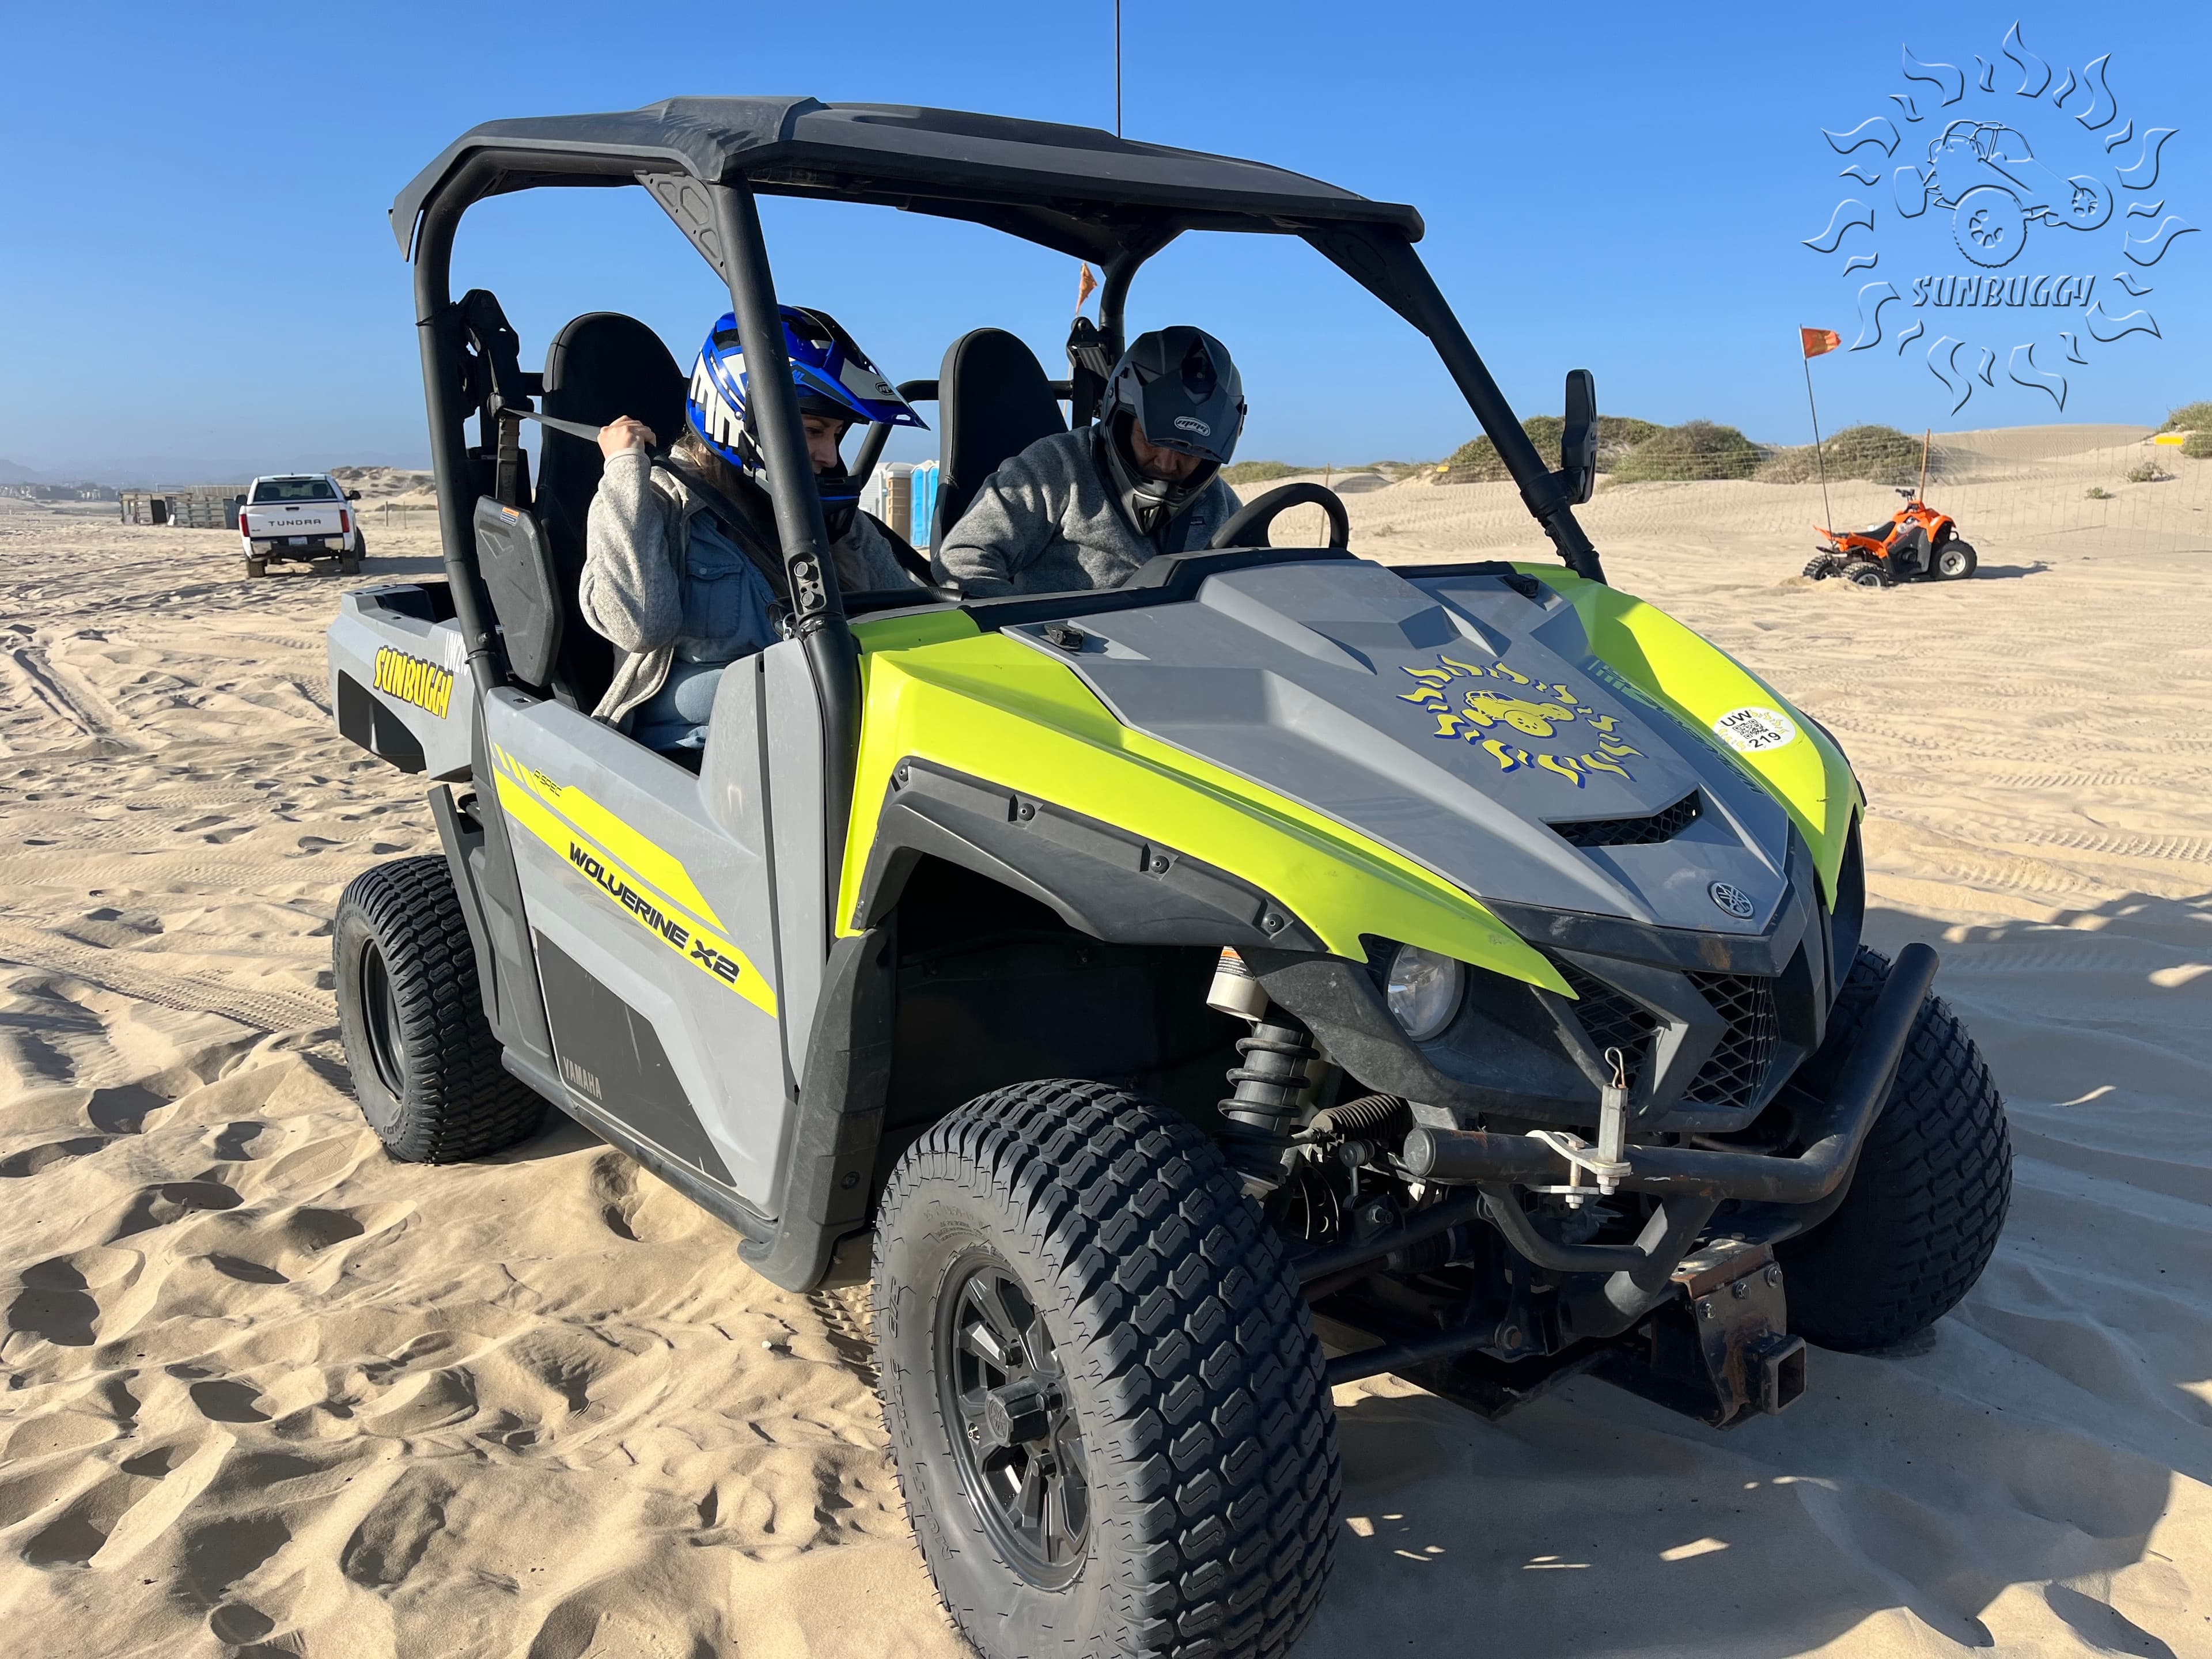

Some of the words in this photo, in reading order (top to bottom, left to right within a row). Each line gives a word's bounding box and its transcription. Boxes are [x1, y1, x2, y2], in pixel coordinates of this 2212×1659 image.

[373, 645, 454, 719] SUNBUGGY
[1721, 710, 1752, 727] UW
[1749, 732, 1781, 748] 219
[570, 840, 690, 949] WOLVERINE
[691, 939, 740, 984] X2
[563, 1056, 603, 1100] YAMAHA
